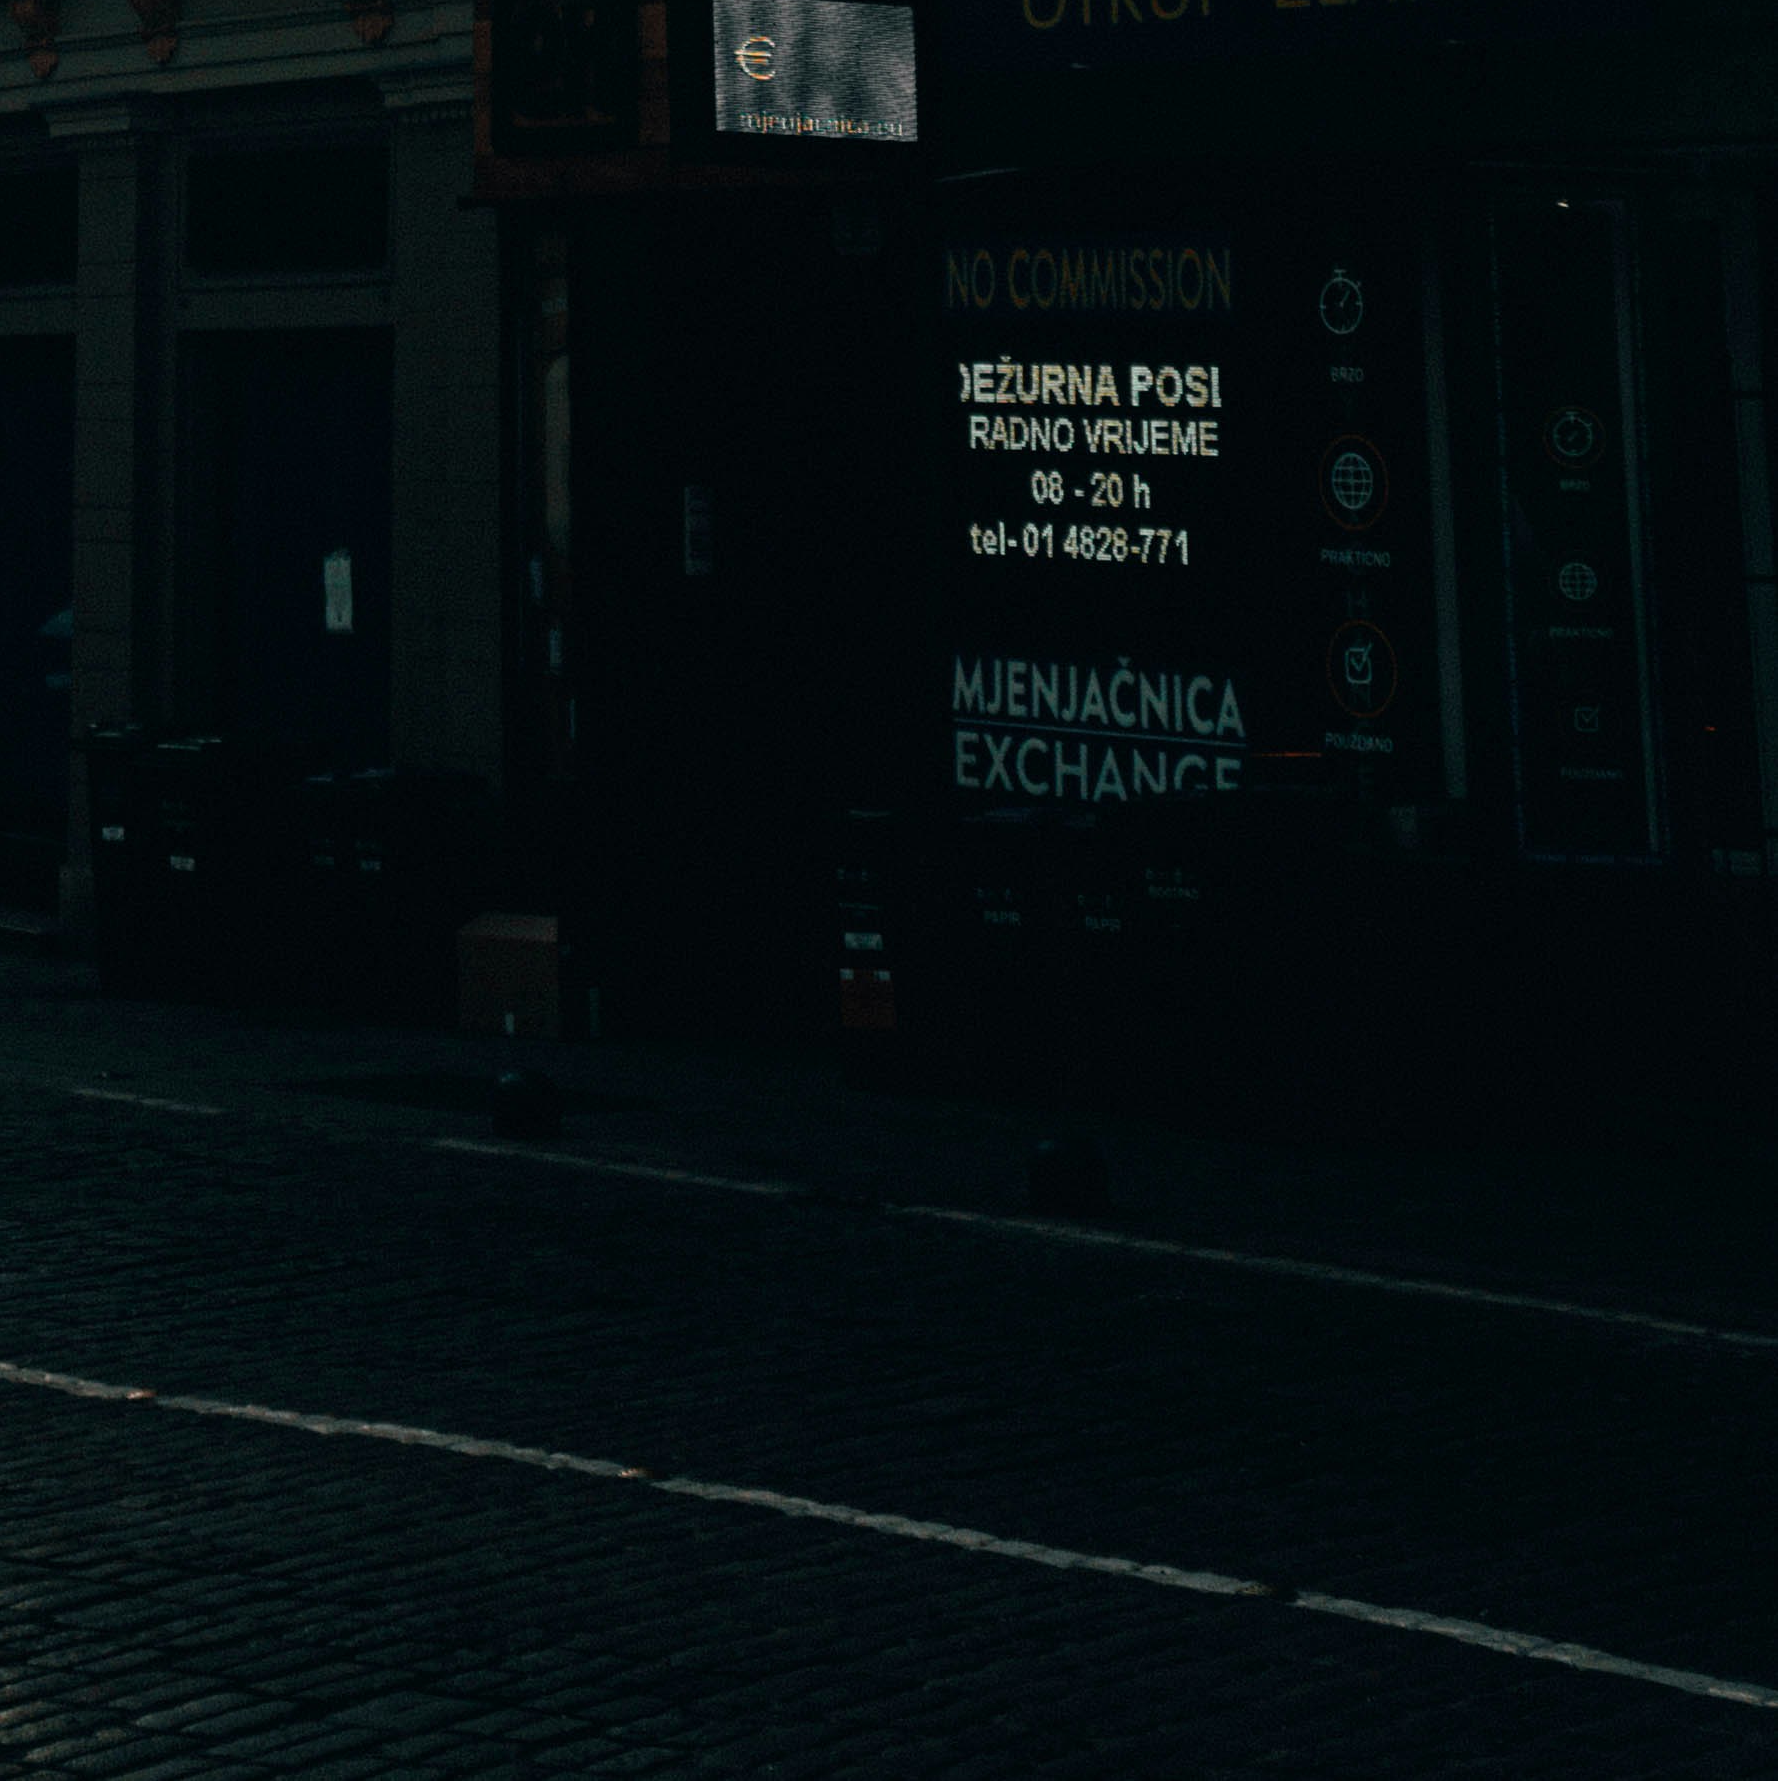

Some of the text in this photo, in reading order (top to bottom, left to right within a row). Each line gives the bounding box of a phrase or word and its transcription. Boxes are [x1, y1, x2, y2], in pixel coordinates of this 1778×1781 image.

[946, 248, 1232, 310] NO COMMISSION
[969, 413, 1220, 457] RADNO VRIJEME
[1030, 468, 1065, 506] 08
[1089, 469, 1124, 509] 20
[1132, 472, 1151, 510] h
[1063, 523, 1190, 566] 4828-771
[951, 653, 1247, 738] MJENJAČNICA
[954, 729, 1243, 802] EXCHANGE
